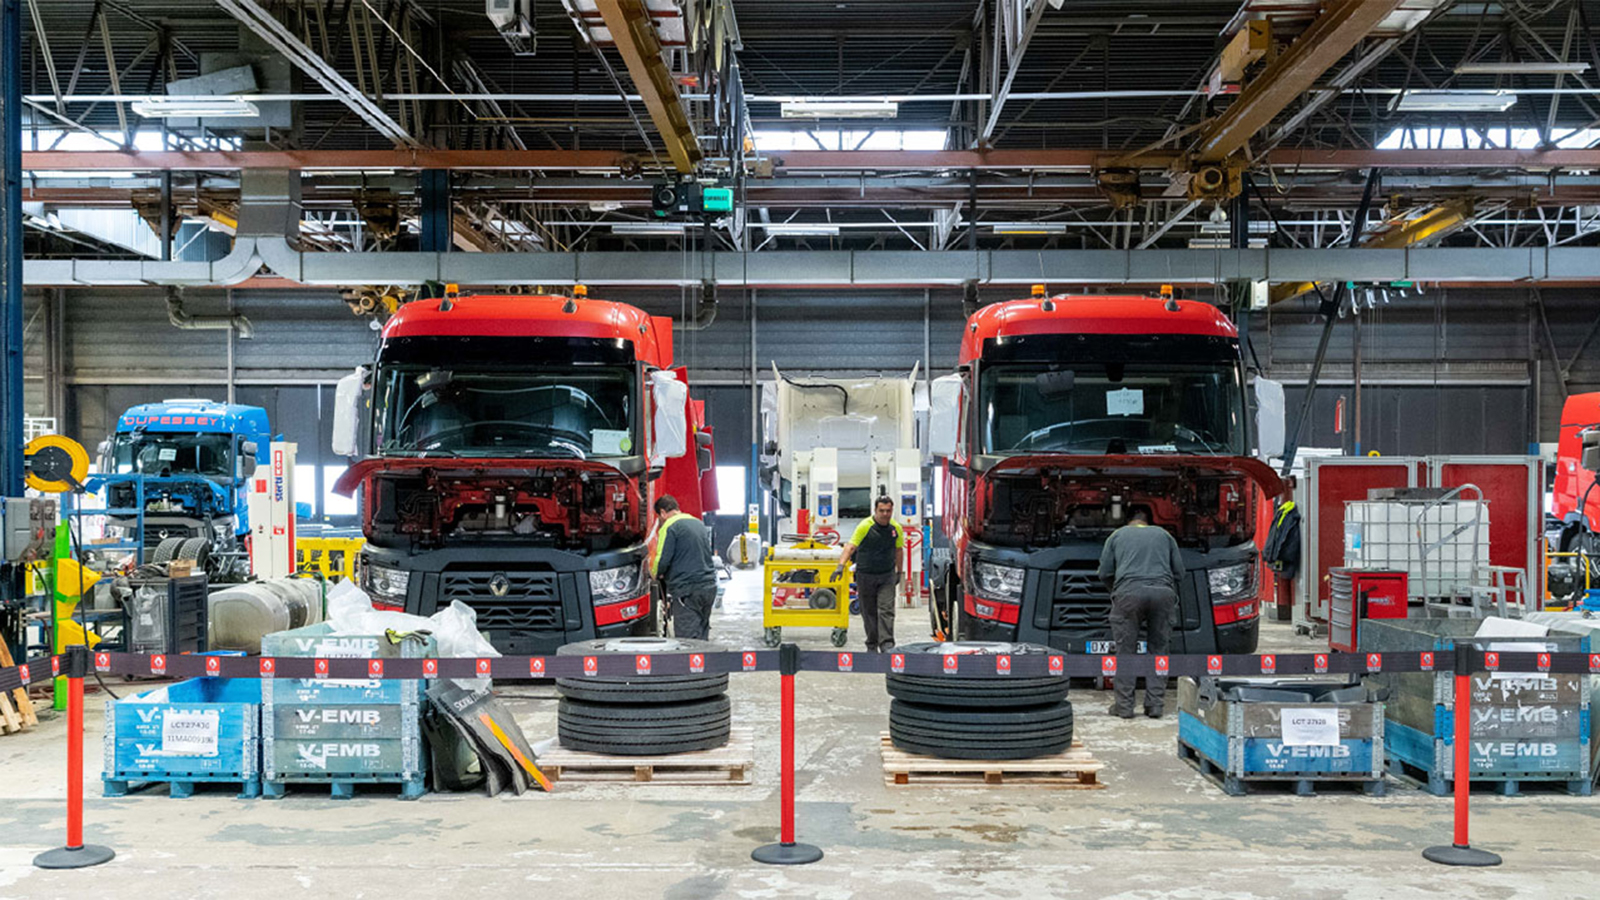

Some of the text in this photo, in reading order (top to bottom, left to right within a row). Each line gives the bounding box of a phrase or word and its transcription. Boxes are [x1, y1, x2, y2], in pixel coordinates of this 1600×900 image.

[297, 709, 380, 723] V-EMB
[1473, 707, 1558, 722] V-EMB
[297, 744, 381, 757] V-EMB
[1267, 744, 1350, 757] V-EMB
[1474, 742, 1558, 756] V-EMB
